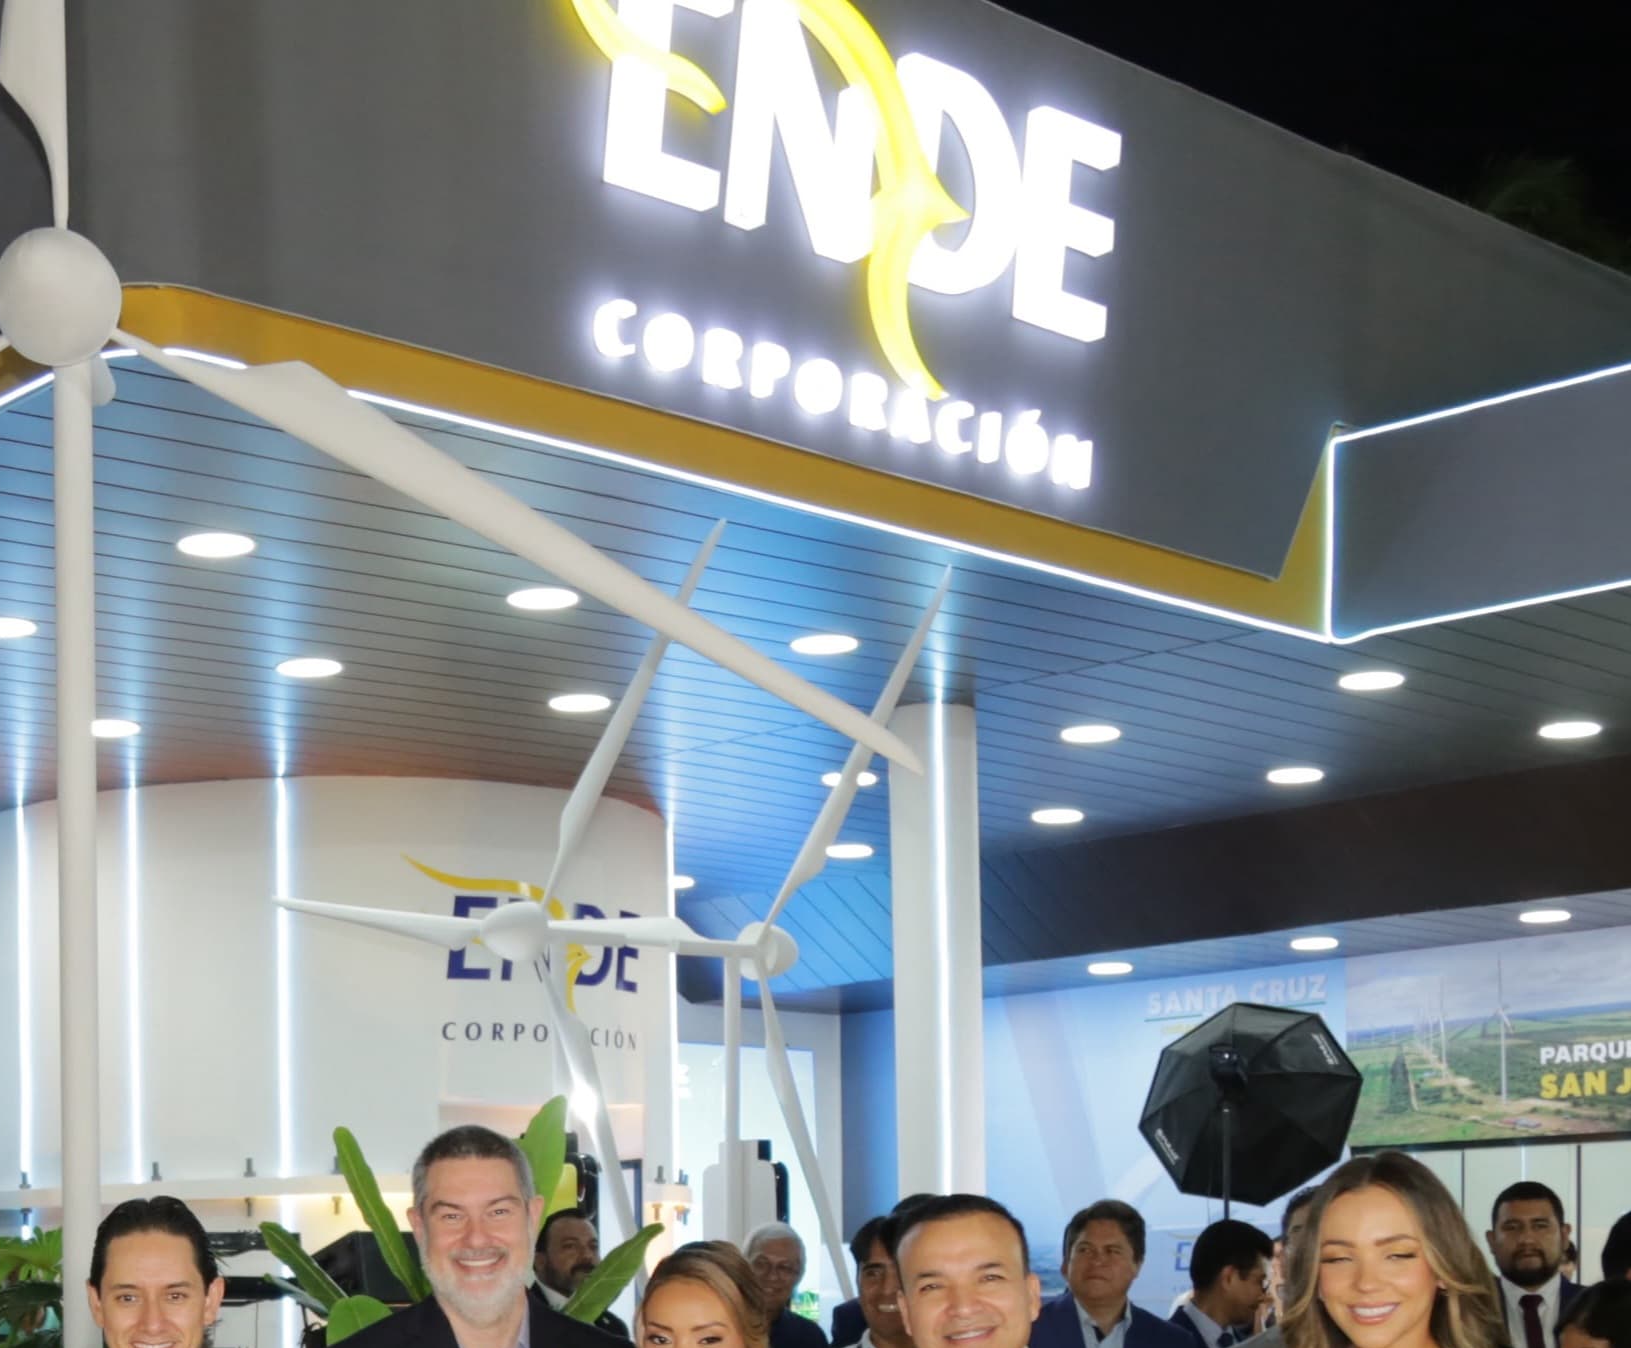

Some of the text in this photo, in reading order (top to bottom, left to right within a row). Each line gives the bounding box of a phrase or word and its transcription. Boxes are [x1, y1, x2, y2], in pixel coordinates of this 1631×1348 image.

[603, 0, 1122, 343] ENDE
[1147, 974, 1328, 1016] SANTA CRUZ
[441, 1021, 638, 1050] CORPOCIÓN
[1540, 1069, 1607, 1099] SAN
